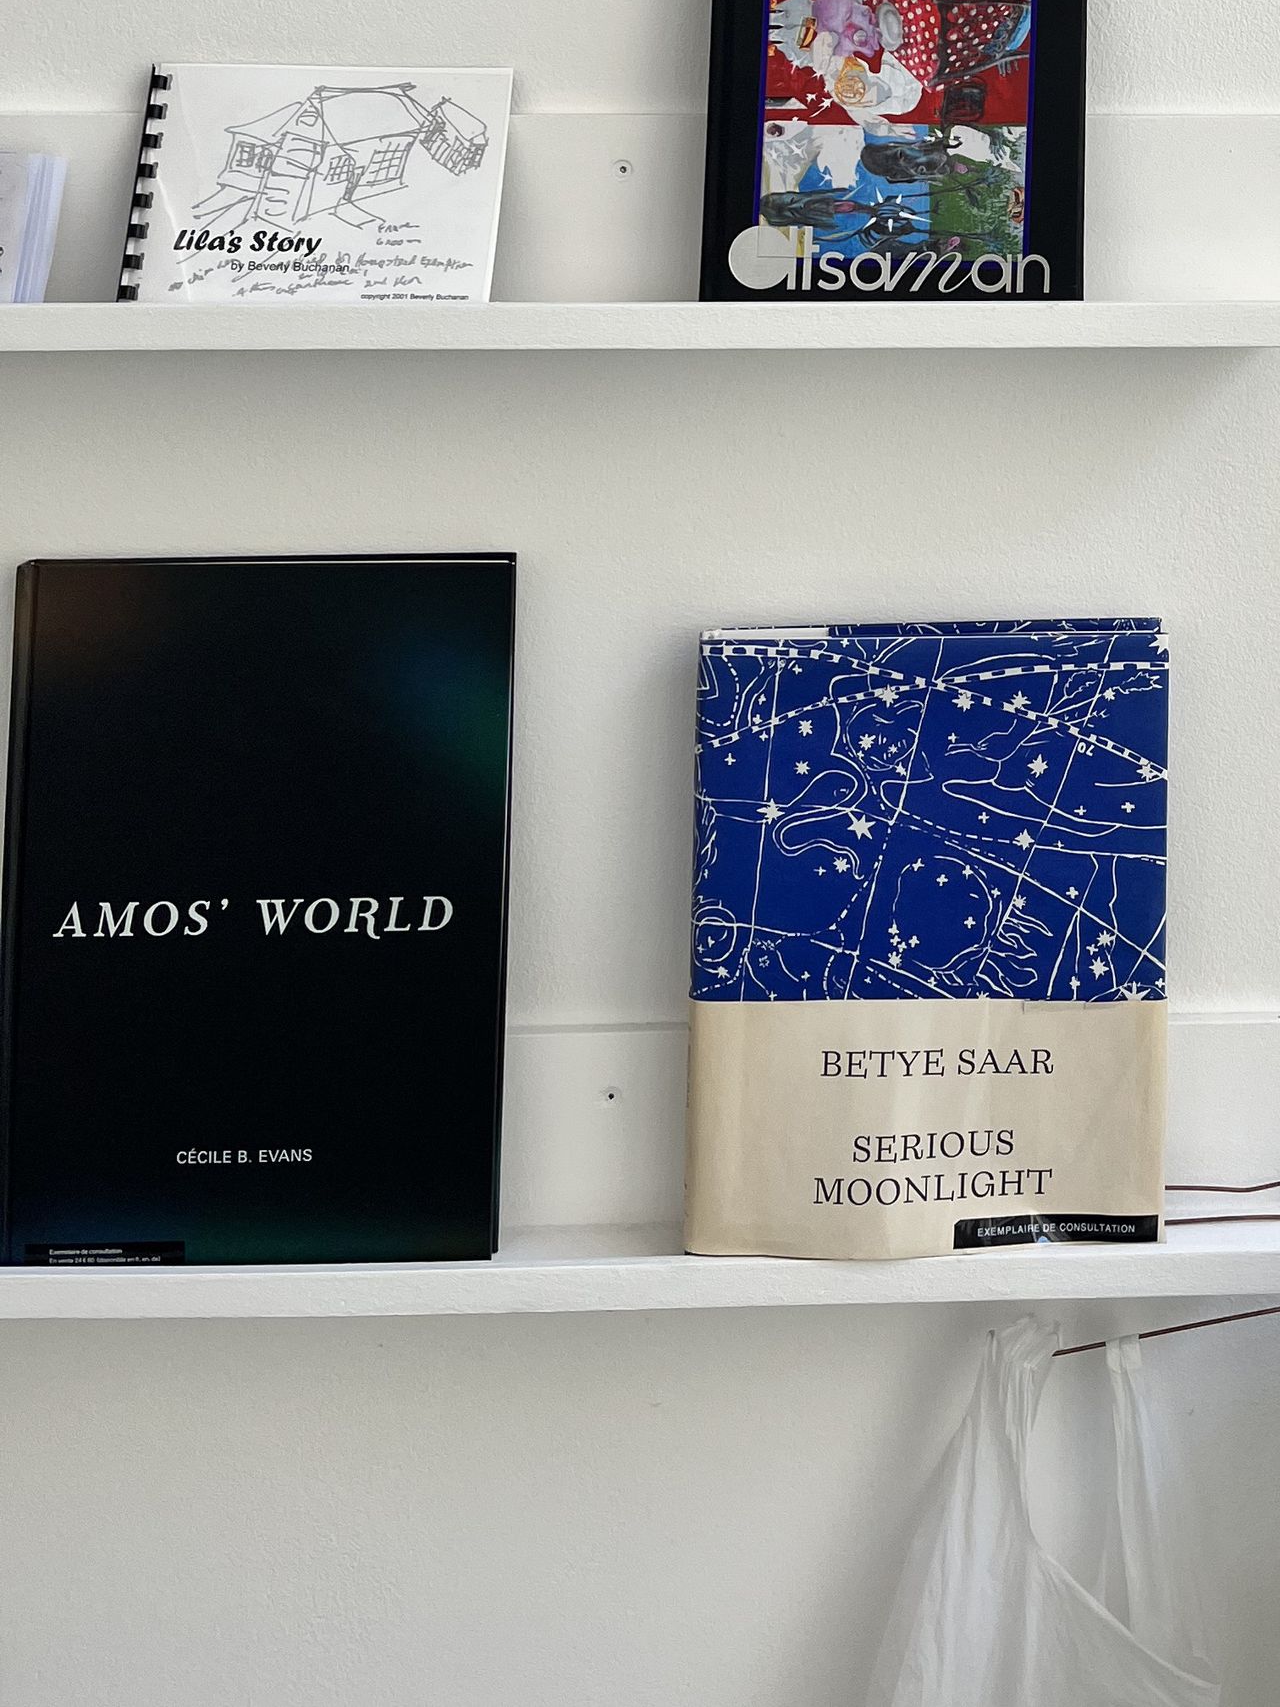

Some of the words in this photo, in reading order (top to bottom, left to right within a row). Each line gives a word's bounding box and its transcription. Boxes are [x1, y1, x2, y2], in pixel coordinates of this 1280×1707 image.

[250, 230, 323, 258] Story
[230, 261, 244, 273] by
[248, 261, 290, 273] Beverly
[293, 261, 350, 273] Buchanan
[256, 895, 454, 940] WORLD
[820, 1048, 945, 1080] BETYE
[956, 1048, 1055, 1076] SAAR
[176, 1148, 233, 1165] CÉCILE
[237, 1150, 252, 1164] B.
[258, 1148, 313, 1164] EVANS
[852, 1128, 1015, 1164] SERIOUS
[813, 1168, 1054, 1206] MOONLIGHT
[978, 1224, 1040, 1237] EXEMPLAIRE
[1043, 1222, 1056, 1233] DE
[1059, 1222, 1135, 1233] CONSULTATION
